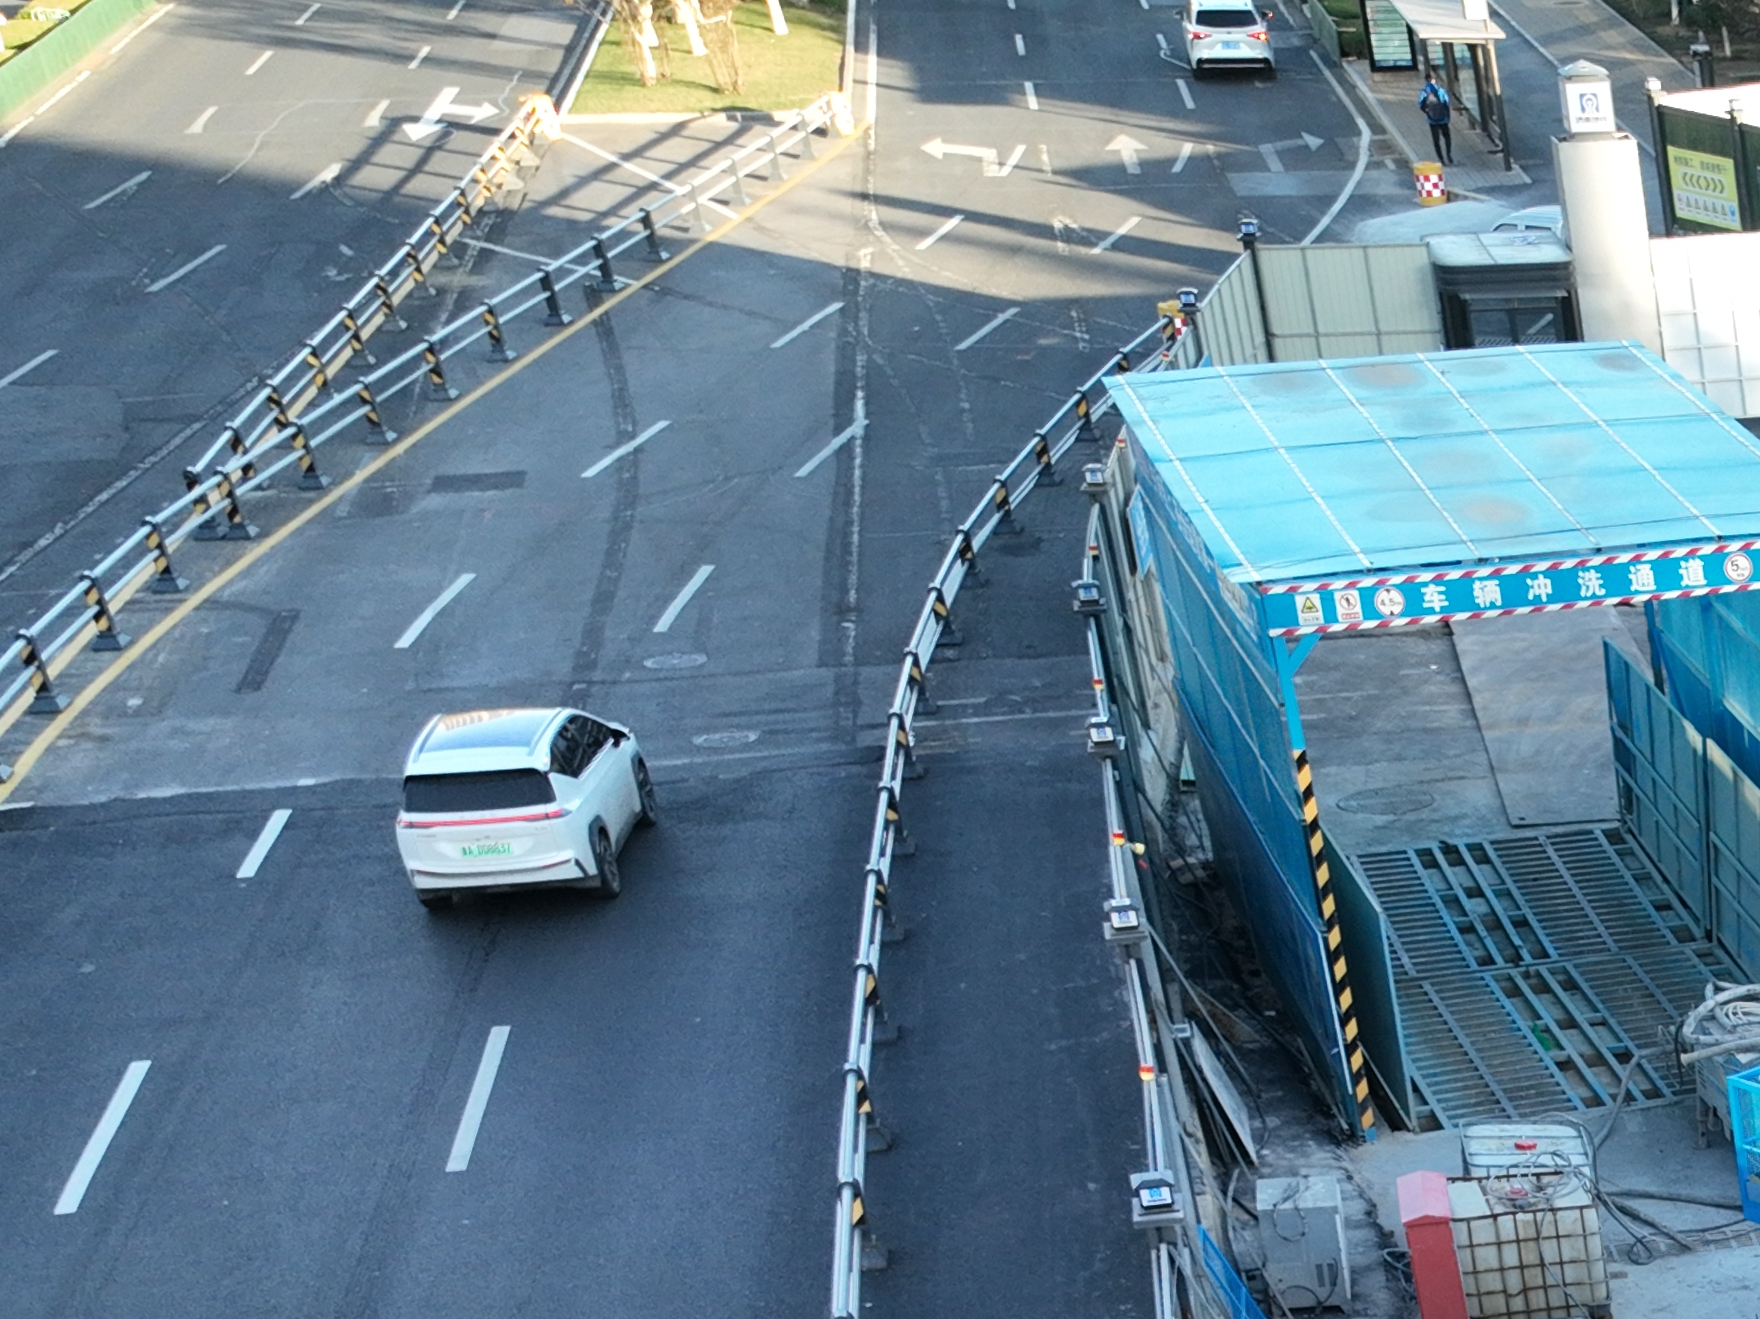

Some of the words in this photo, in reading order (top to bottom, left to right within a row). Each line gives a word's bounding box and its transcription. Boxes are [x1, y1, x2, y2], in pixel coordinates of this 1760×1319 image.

[1420, 557, 1708, 613] 车辆冲洗通道
